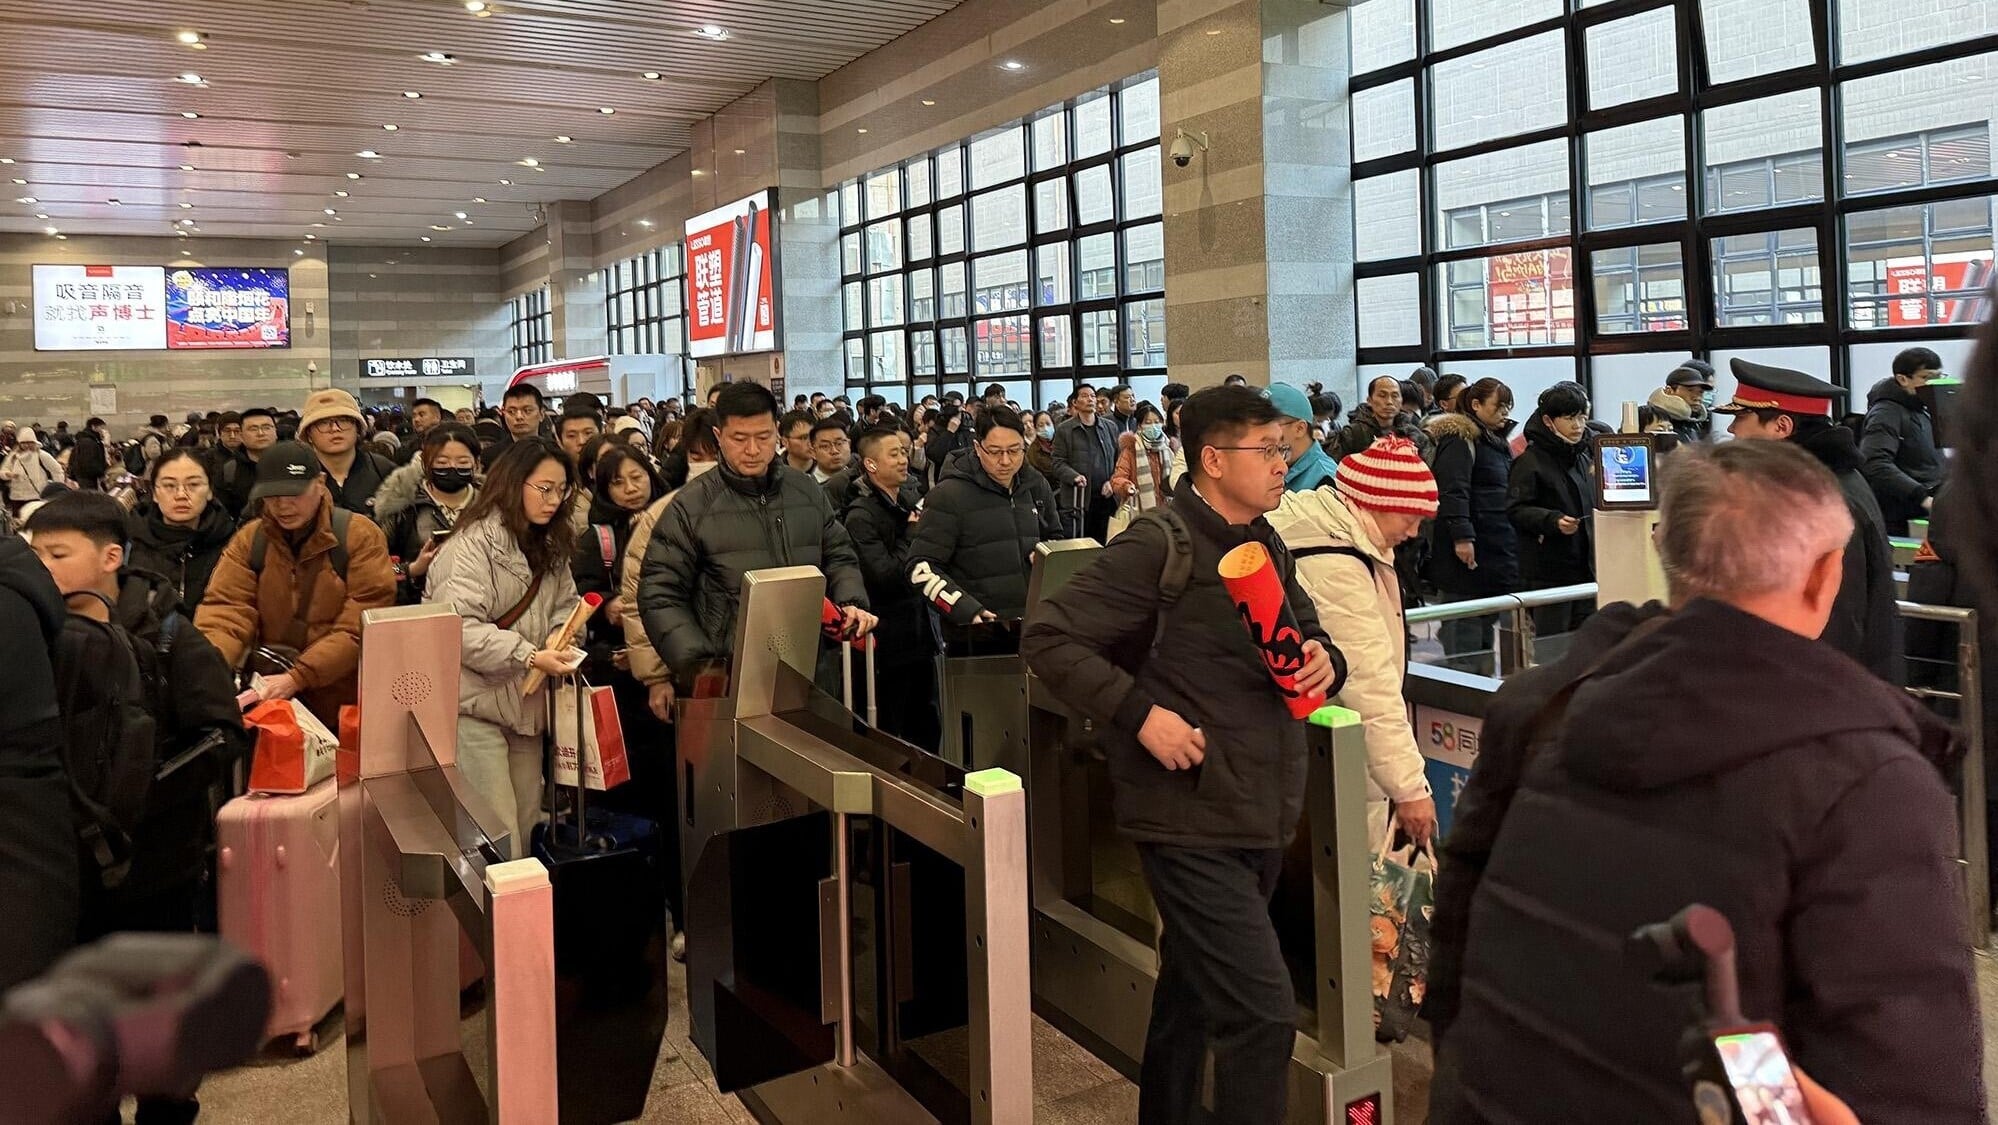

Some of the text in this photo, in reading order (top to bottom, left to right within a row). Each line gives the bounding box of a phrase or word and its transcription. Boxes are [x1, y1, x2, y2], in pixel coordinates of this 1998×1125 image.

[695, 249, 722, 289] 联塑
[55, 283, 144, 301] 吸音隔音
[44, 304, 155, 321] 就找声博士
[697, 287, 725, 328] 管道
[440, 359, 466, 370] 卫生间
[1431, 720, 1478, 756] 58同
